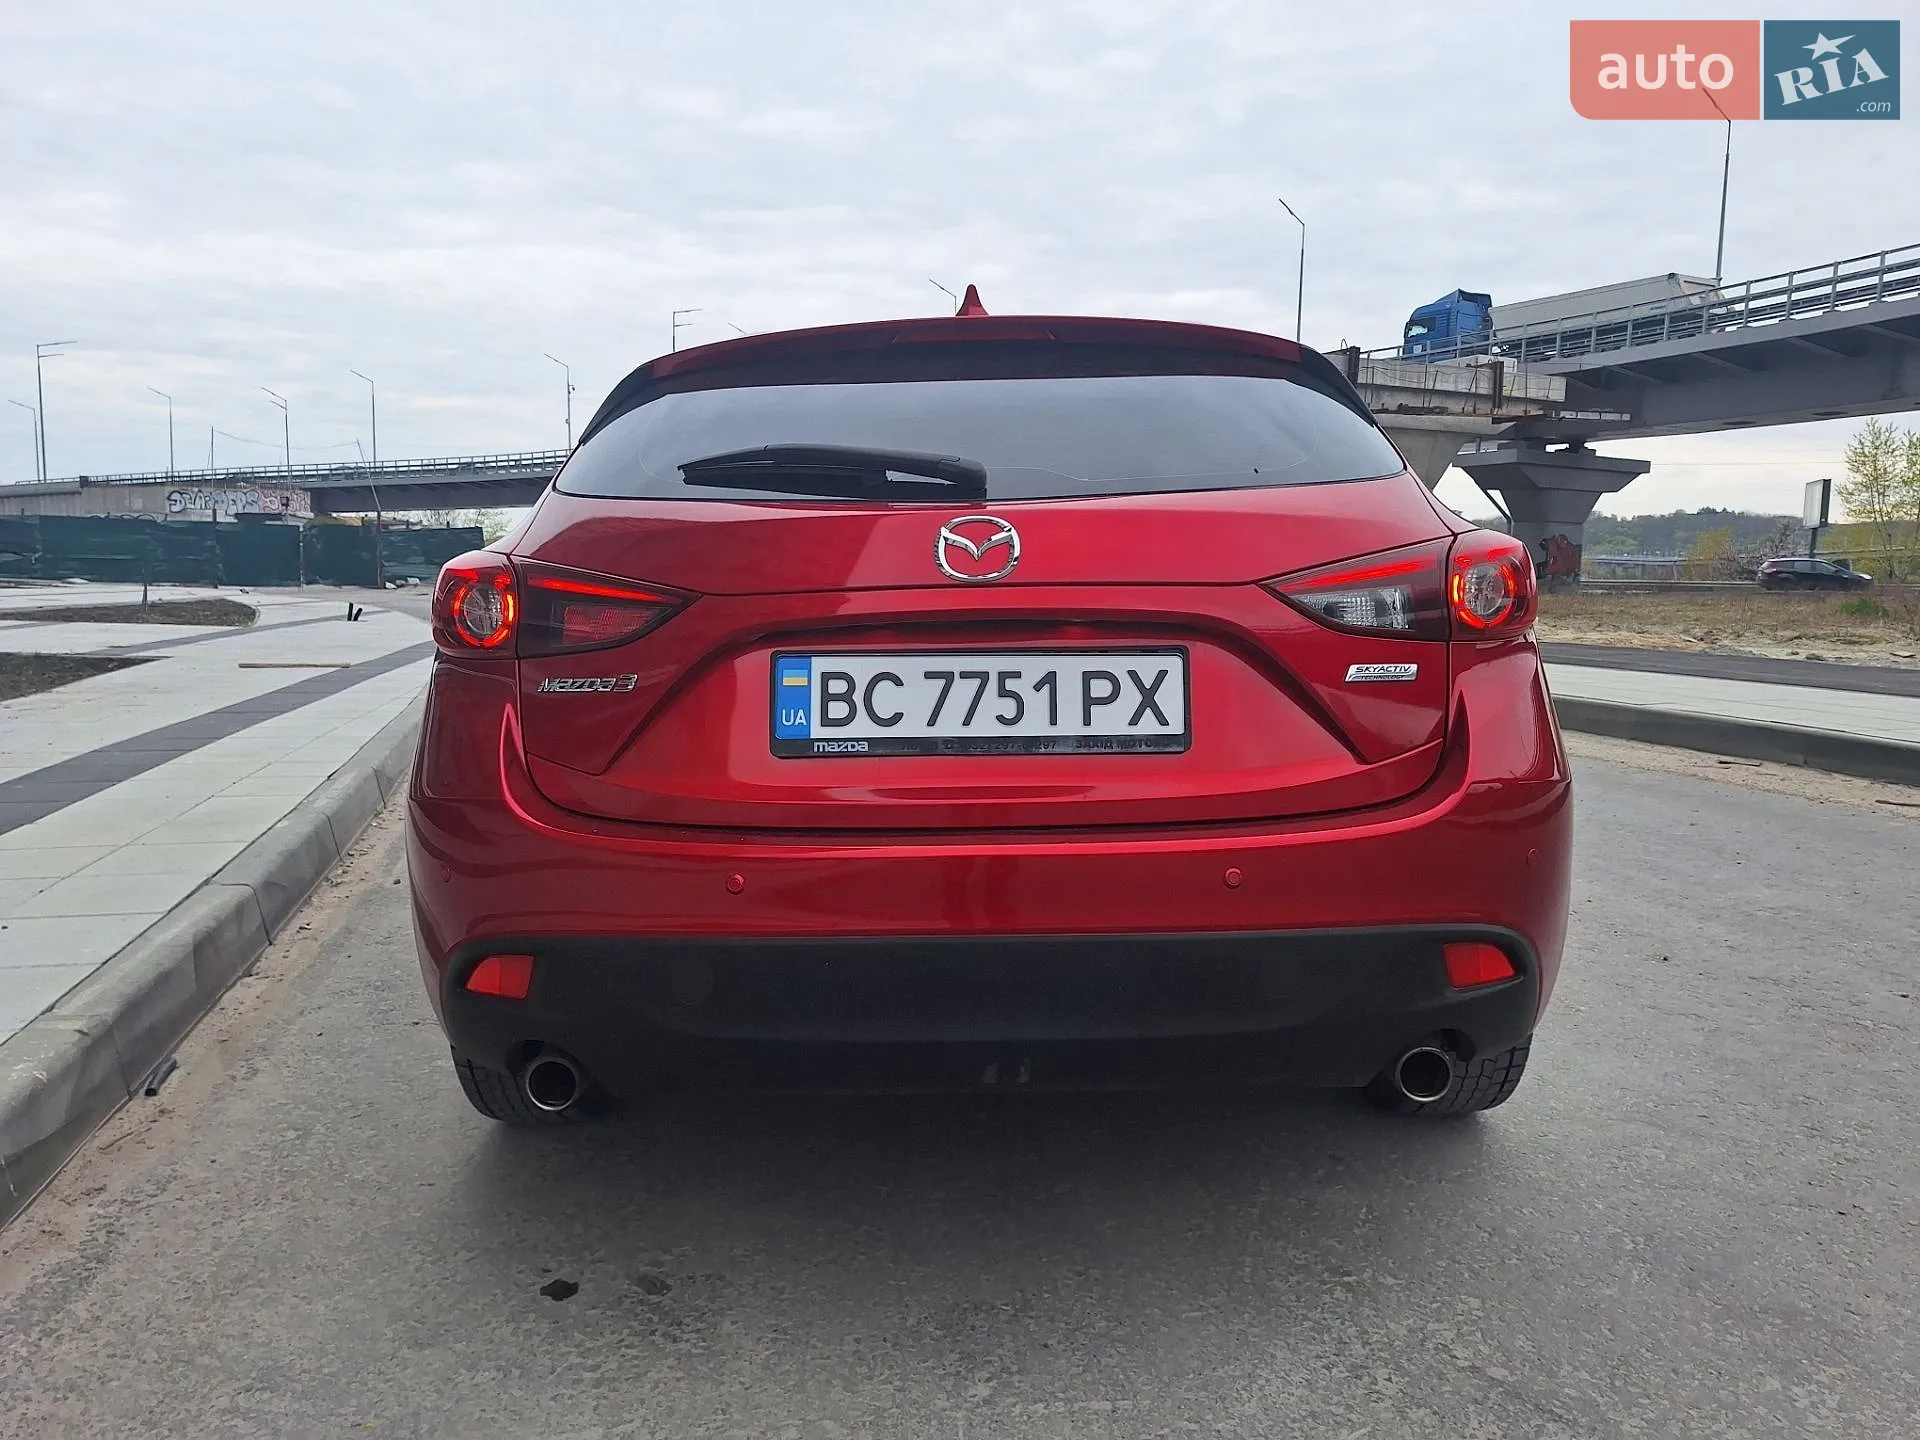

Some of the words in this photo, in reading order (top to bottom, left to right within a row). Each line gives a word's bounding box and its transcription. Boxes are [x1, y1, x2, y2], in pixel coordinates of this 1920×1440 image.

[1355, 665, 1411, 673] SKYACTIV
[820, 671, 905, 728] BC
[923, 670, 1058, 727] 7751
[1082, 669, 1170, 727] PX
[781, 709, 807, 726] UA
